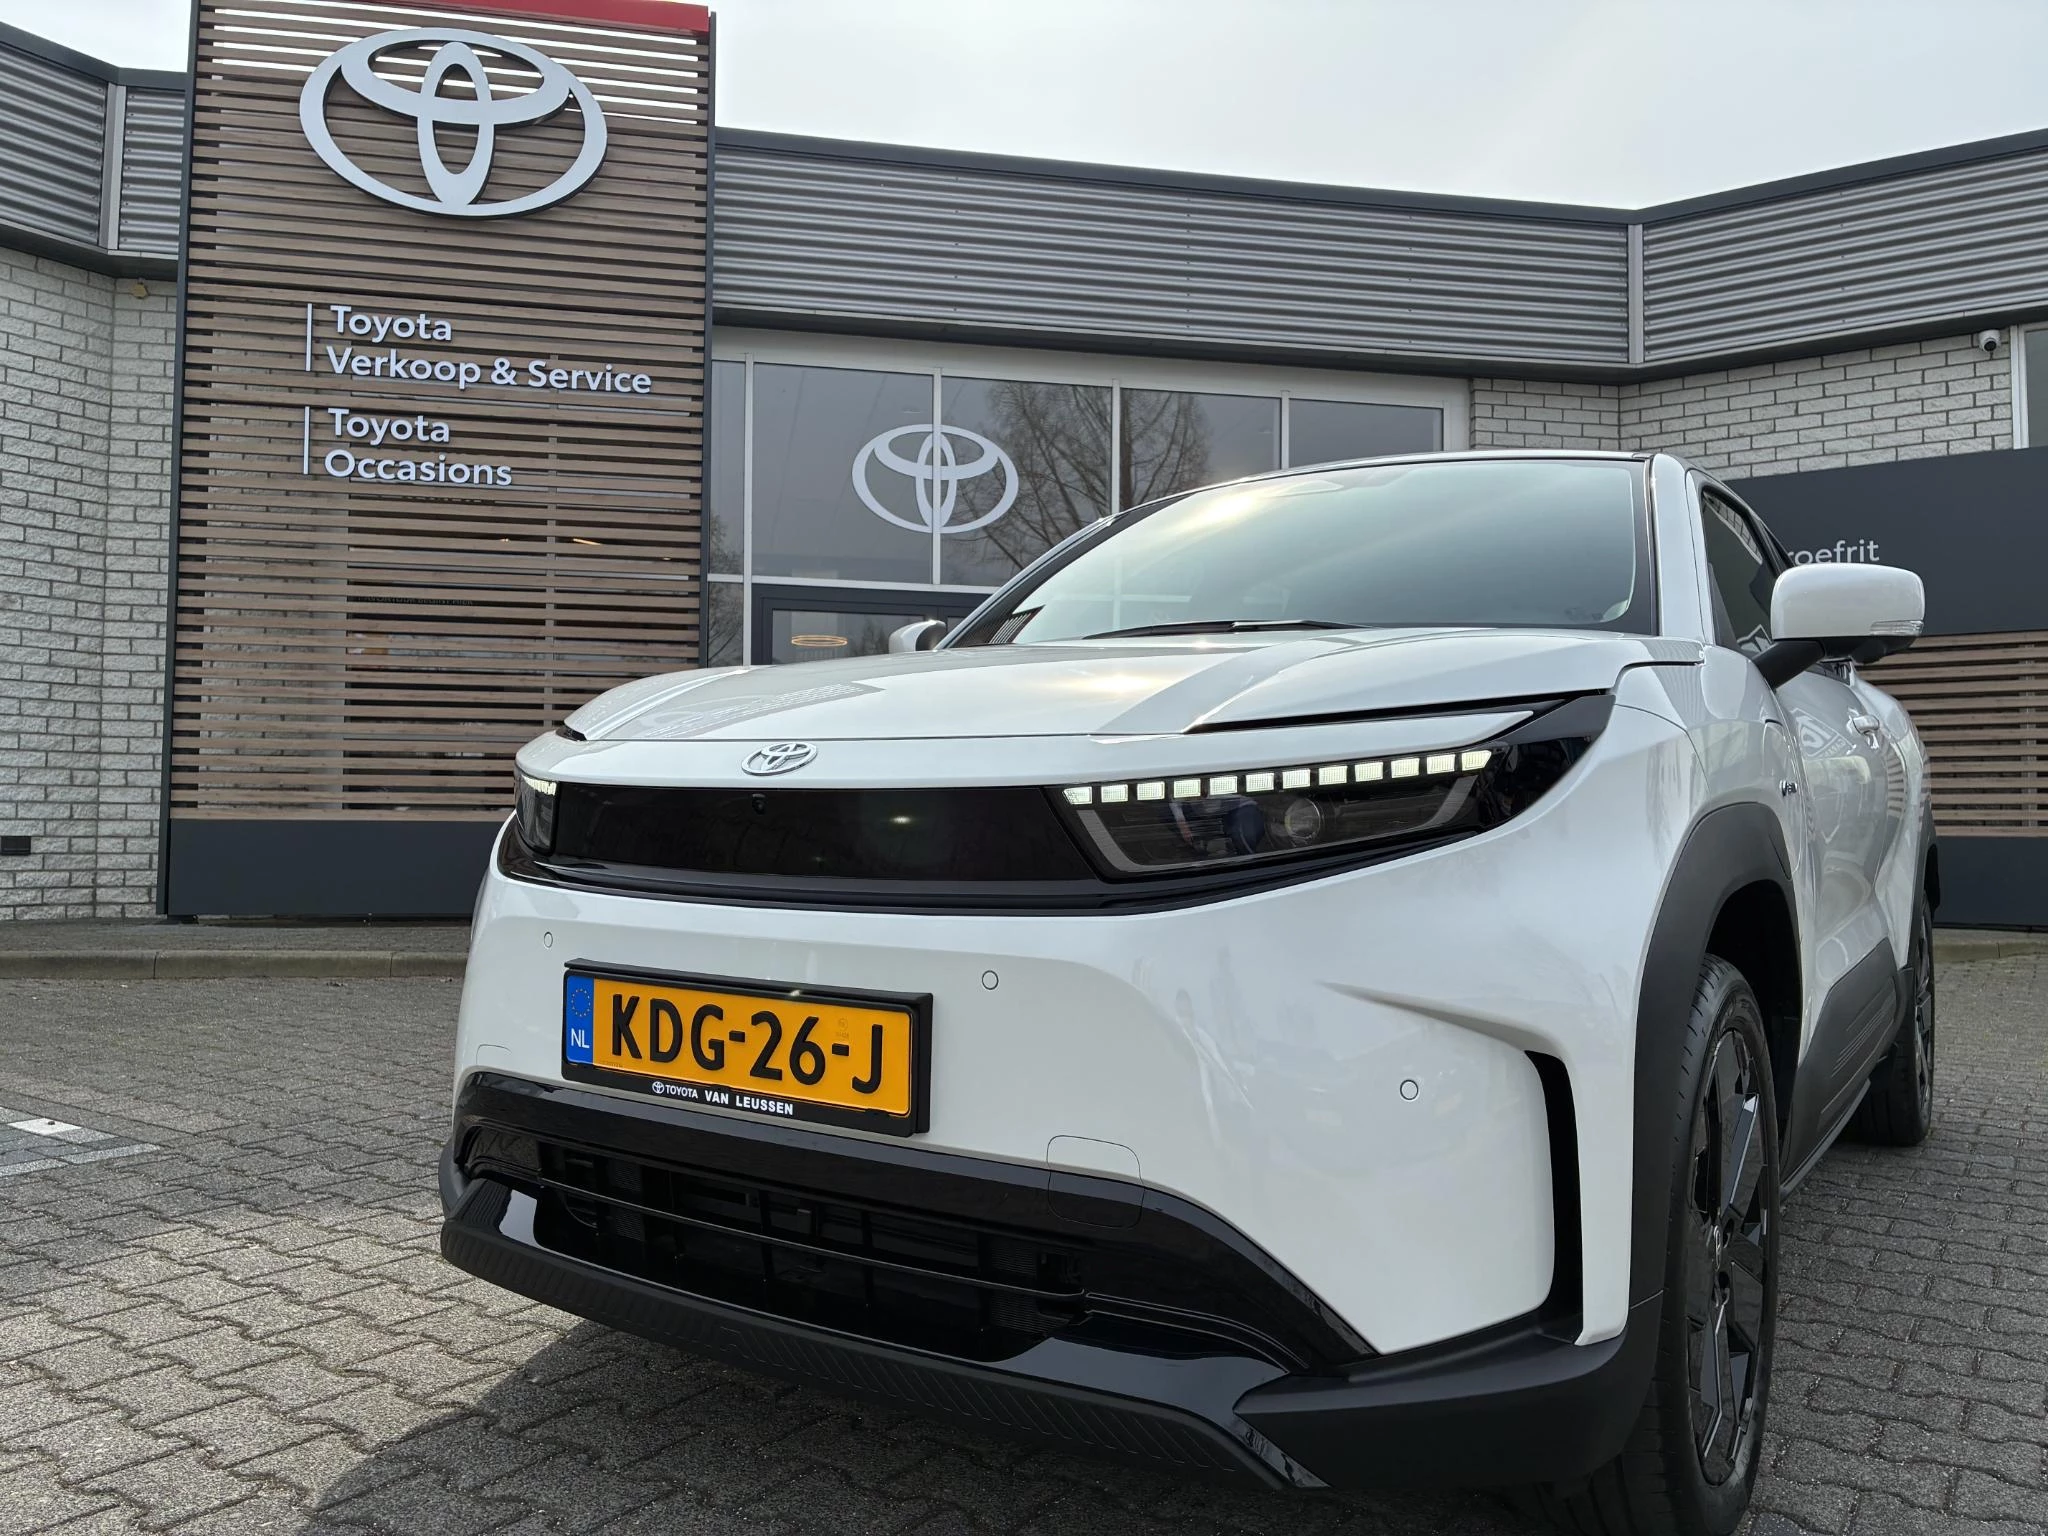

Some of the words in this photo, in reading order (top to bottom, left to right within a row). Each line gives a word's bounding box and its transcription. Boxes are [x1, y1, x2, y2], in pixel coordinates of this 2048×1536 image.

[330, 305, 453, 344] Toyota
[326, 345, 481, 391] Verkoop
[490, 357, 518, 386] &
[528, 359, 652, 394] Service
[327, 408, 451, 446] Toyota
[324, 449, 513, 486] Occasions
[570, 1028, 590, 1050] NL
[611, 994, 884, 1094] KDG-26-J
[665, 1084, 699, 1099] TOYOTA
[705, 1090, 729, 1105] VAN
[736, 1095, 794, 1116] LEUSSEN
